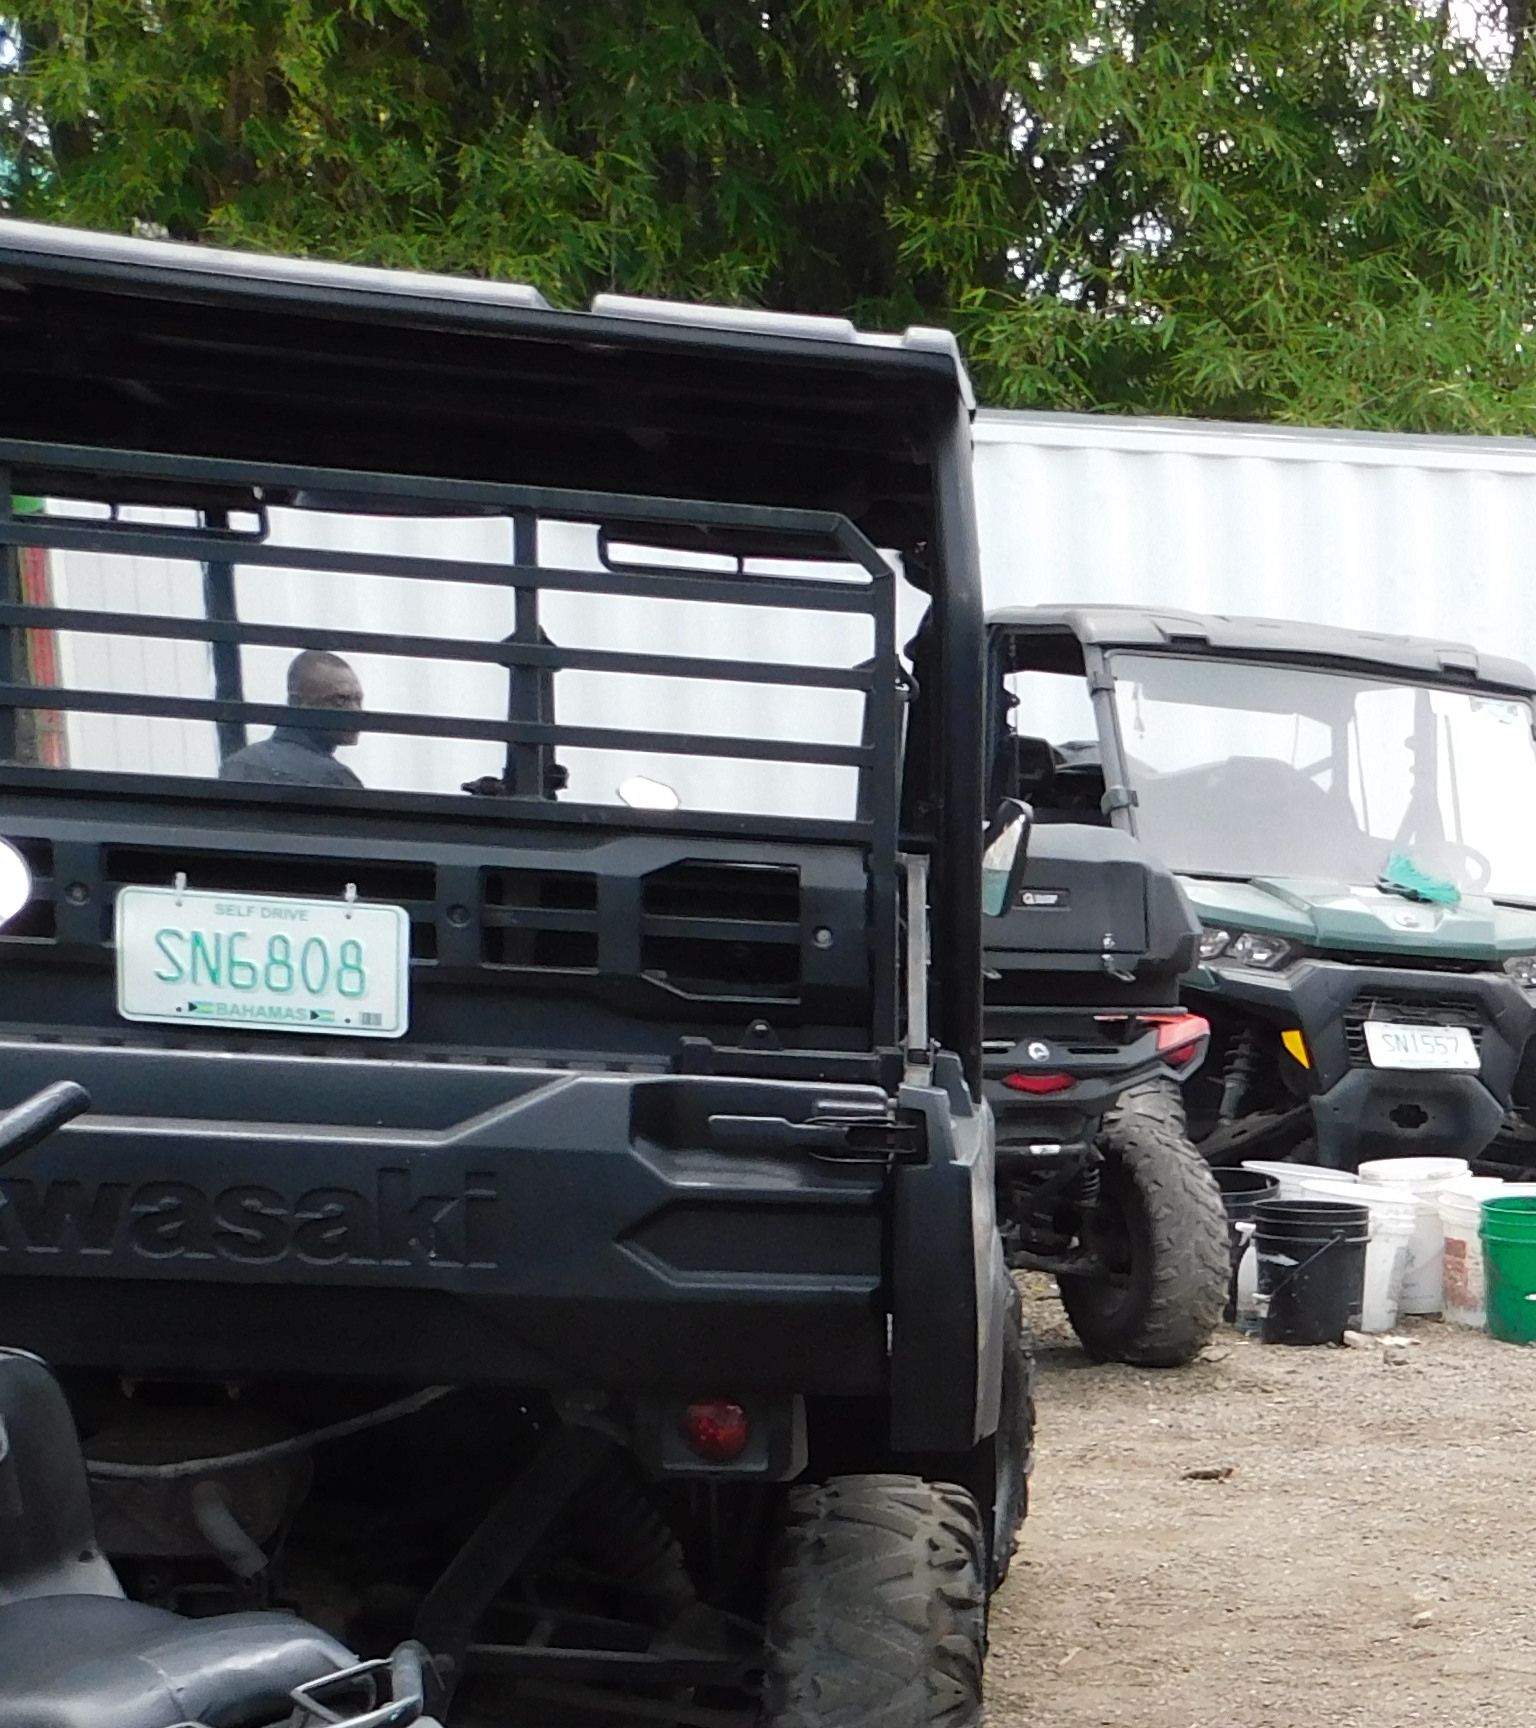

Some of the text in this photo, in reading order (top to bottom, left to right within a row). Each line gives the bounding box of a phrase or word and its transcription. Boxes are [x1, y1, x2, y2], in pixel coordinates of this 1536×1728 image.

[215, 903, 309, 922] SELF DRIVE
[154, 927, 366, 998] SN6808
[216, 1002, 308, 1021] BAHAMAS
[1381, 1033, 1459, 1055] SN1557
